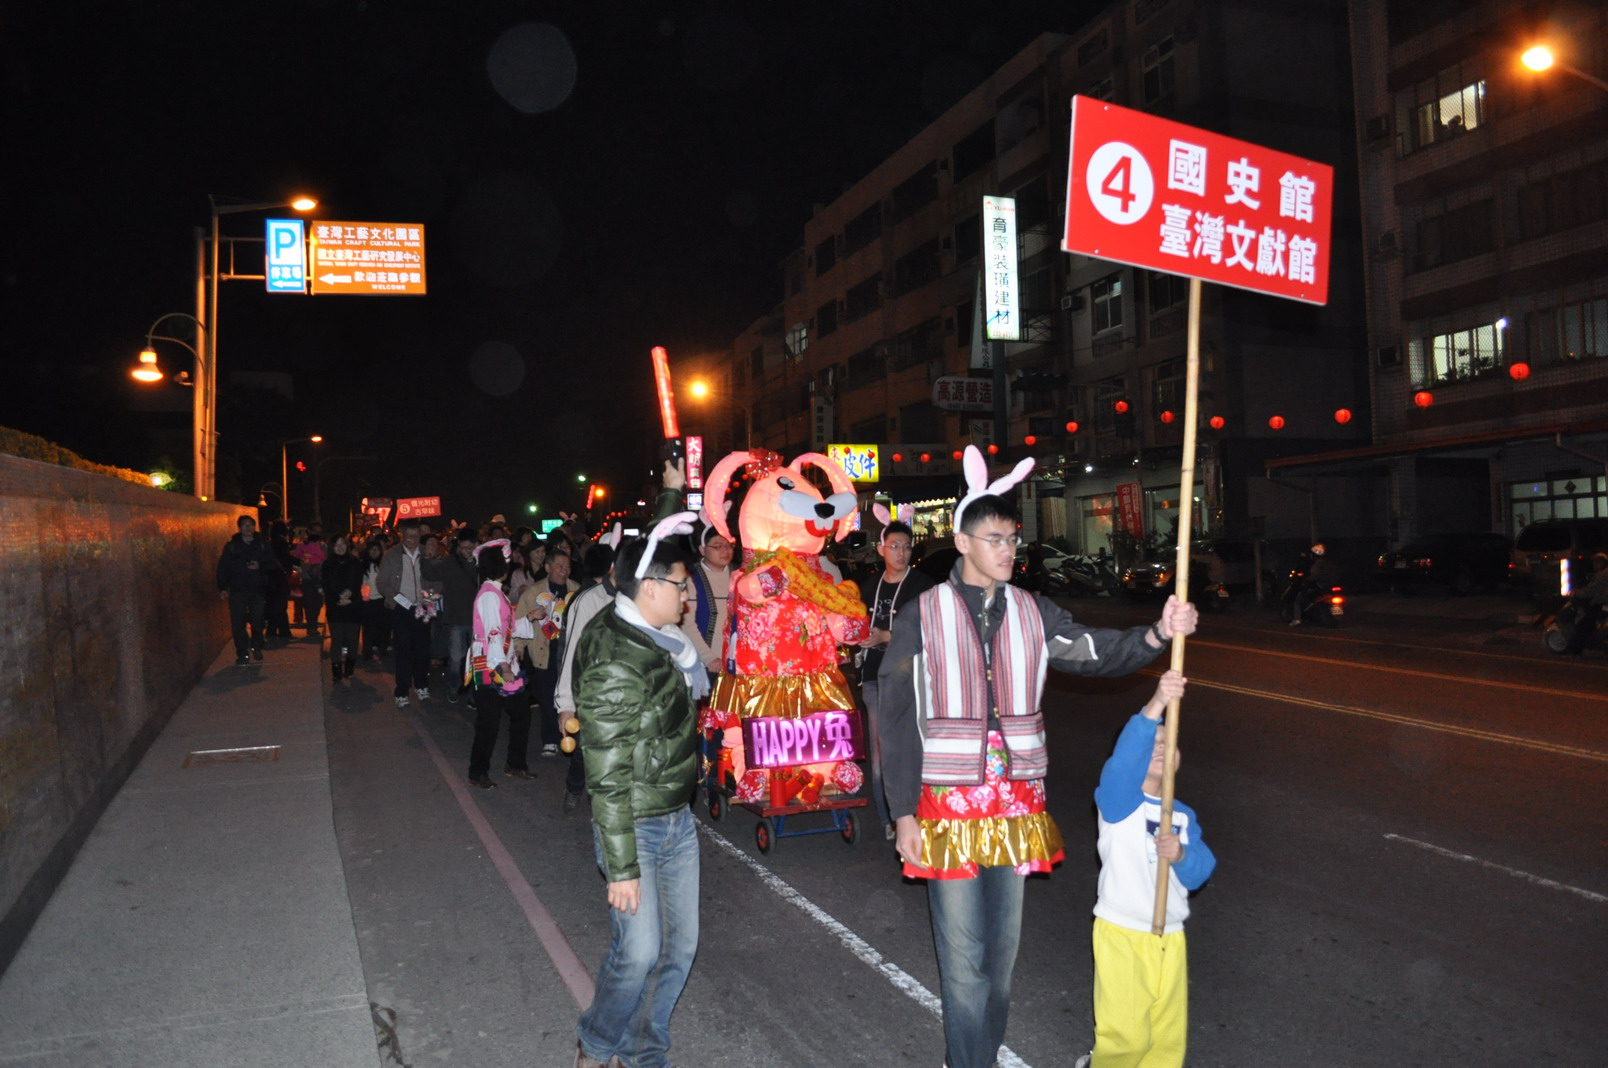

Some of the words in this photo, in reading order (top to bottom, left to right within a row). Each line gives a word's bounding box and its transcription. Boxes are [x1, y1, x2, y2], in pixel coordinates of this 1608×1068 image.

[1100, 155, 1136, 214] 4
[1166, 138, 1316, 223] 國史館
[275, 228, 296, 259] P
[317, 225, 420, 240] 臺灣工藝文化園區
[1158, 203, 1317, 285] 臺灣文獻館
[937, 380, 992, 403] 高源營造
